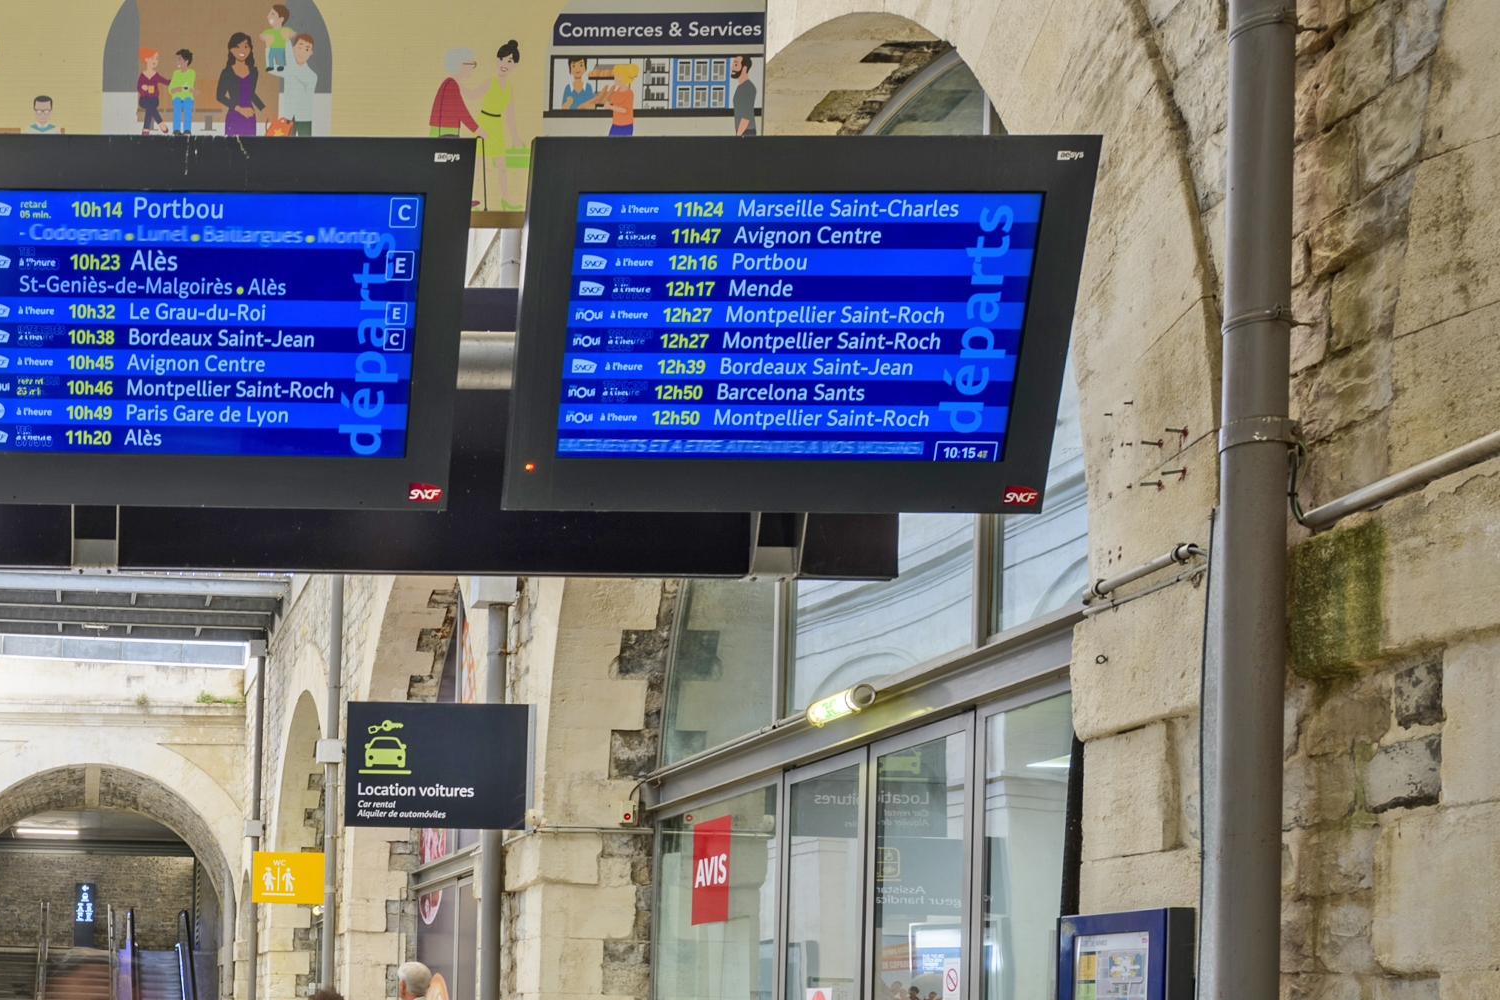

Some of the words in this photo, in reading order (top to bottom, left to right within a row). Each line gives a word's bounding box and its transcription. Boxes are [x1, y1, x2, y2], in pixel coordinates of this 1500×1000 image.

[559, 22, 663, 37] Commerces
[669, 22, 682, 37] &
[689, 21, 761, 36] Services
[20, 200, 47, 208] retard
[72, 201, 122, 217] 10h14
[134, 197, 223, 219] Portbou
[398, 204, 412, 222] C
[621, 205, 626, 213] à
[628, 205, 659, 213] l'heure
[675, 202, 723, 217] 11h24
[738, 199, 824, 217] Marseille
[830, 199, 959, 217] Saint-Charles
[20, 210, 30, 218] 05
[137, 225, 189, 243] Lunel
[203, 225, 303, 248] Baillargues
[672, 229, 721, 243] 11h47
[734, 226, 811, 248] Avignon
[817, 226, 881, 244] Centre
[70, 254, 120, 270] 10h23
[130, 250, 177, 271] Alès
[394, 258, 407, 274] E
[615, 258, 621, 266] à
[623, 258, 653, 266] l'heure
[669, 255, 717, 270] 12h16
[732, 253, 807, 270] Portbou
[20, 275, 232, 299] St-Geniès-de-Malgoirès
[248, 278, 286, 295] Alès
[666, 281, 715, 296] 12h17
[729, 279, 793, 297] Mende
[18, 306, 23, 314] à
[25, 306, 54, 315] l'heure
[69, 304, 115, 319] 10h32
[130, 303, 150, 319] Le
[156, 303, 266, 321] Grau-du-Roi
[392, 307, 401, 320] E
[618, 311, 648, 319] l'heure
[663, 308, 712, 322] 12h27
[726, 306, 836, 327] Montpellier
[841, 306, 944, 323] Saint-Roch
[938, 204, 1014, 433] départs
[68, 330, 114, 345] 10h38
[129, 328, 212, 346] Bordeaux
[218, 329, 314, 347] Saint-Jean
[389, 333, 400, 346] C
[338, 232, 399, 456] départs
[660, 334, 709, 348] 12h27
[723, 332, 833, 353] Montpellier
[837, 332, 940, 349] Saint-Roch
[17, 357, 22, 365] à
[24, 357, 53, 366] l'heure
[68, 355, 114, 370] 10h45
[127, 354, 199, 375] Avignon
[205, 355, 265, 372] Centre
[605, 362, 610, 370] à
[613, 362, 643, 370] l'heure
[658, 359, 705, 374] 12h39
[720, 358, 807, 374] Bordeaux
[813, 358, 913, 375] Saint-Jean
[67, 380, 113, 395] 10h46
[127, 379, 231, 400] Montpellier
[236, 381, 334, 398] Saint-Roch
[655, 385, 703, 400] 12h50
[717, 383, 807, 400] Barcelona
[813, 384, 864, 401] Sants
[16, 407, 21, 415] à
[23, 408, 52, 416] l'heure
[66, 405, 112, 420] 10h49
[126, 404, 168, 421] Paris
[173, 405, 214, 422] Gare
[219, 406, 241, 422] de
[247, 406, 288, 427] Lyon
[600, 413, 605, 421] à
[607, 413, 637, 421] l'heure
[652, 411, 700, 425] 12h50
[714, 409, 822, 430] Montpellier
[827, 410, 929, 426] Saint-Roch
[66, 430, 111, 445] 11h20
[124, 429, 162, 446] Alès
[944, 447, 976, 458] 10:15
[409, 489, 441, 499] SNCF
[1004, 493, 1037, 502] SNCF
[358, 783, 416, 796] Location
[419, 784, 474, 797] voitures
[358, 800, 372, 808] Car
[357, 809, 387, 818] Alquiler
[399, 810, 446, 818] automóviles
[695, 854, 727, 888] AVIS
